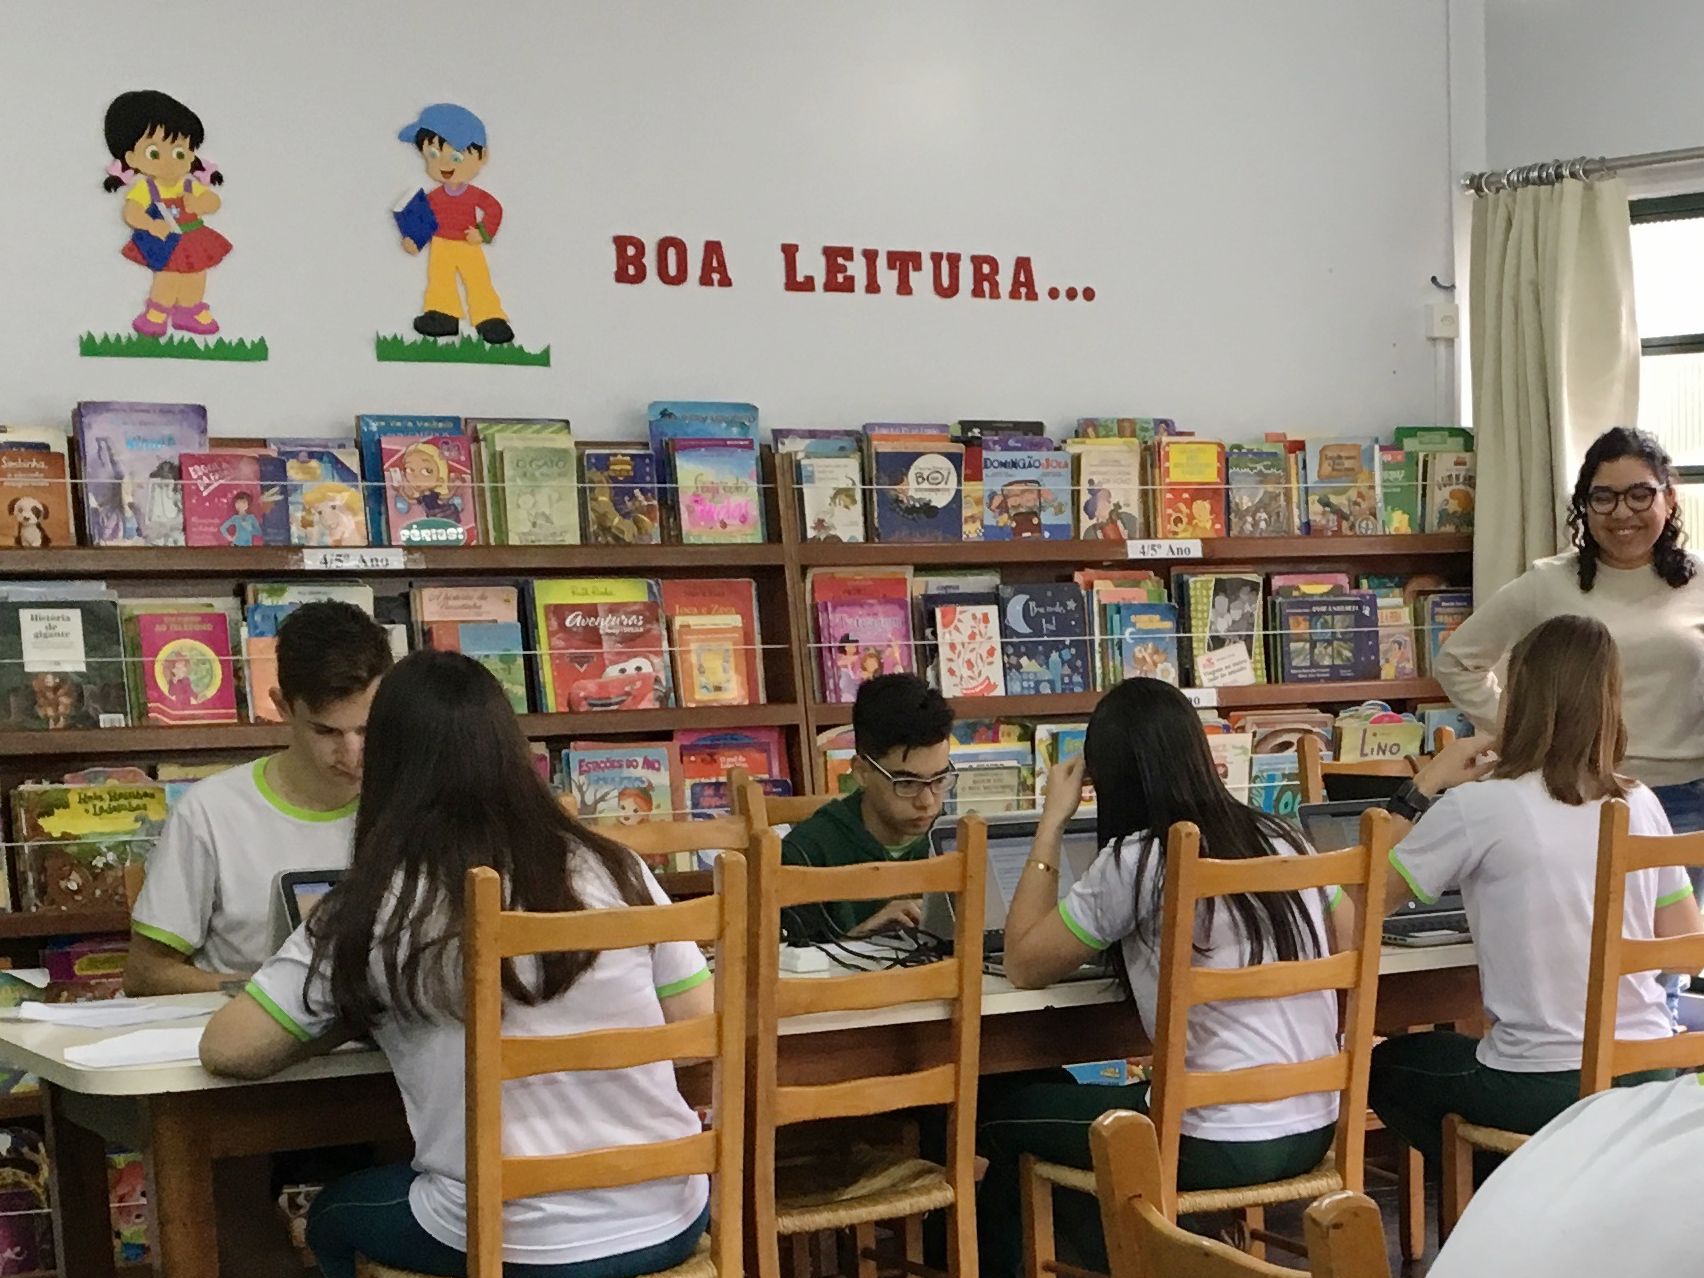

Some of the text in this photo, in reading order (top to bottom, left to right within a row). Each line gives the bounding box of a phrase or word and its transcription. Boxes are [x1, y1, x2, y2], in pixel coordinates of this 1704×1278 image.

[612, 234, 1096, 302] BOA LEITURA...
[1166, 544, 1191, 556] Ano
[357, 554, 390, 568] Ano
[565, 611, 644, 629] Aventuras
